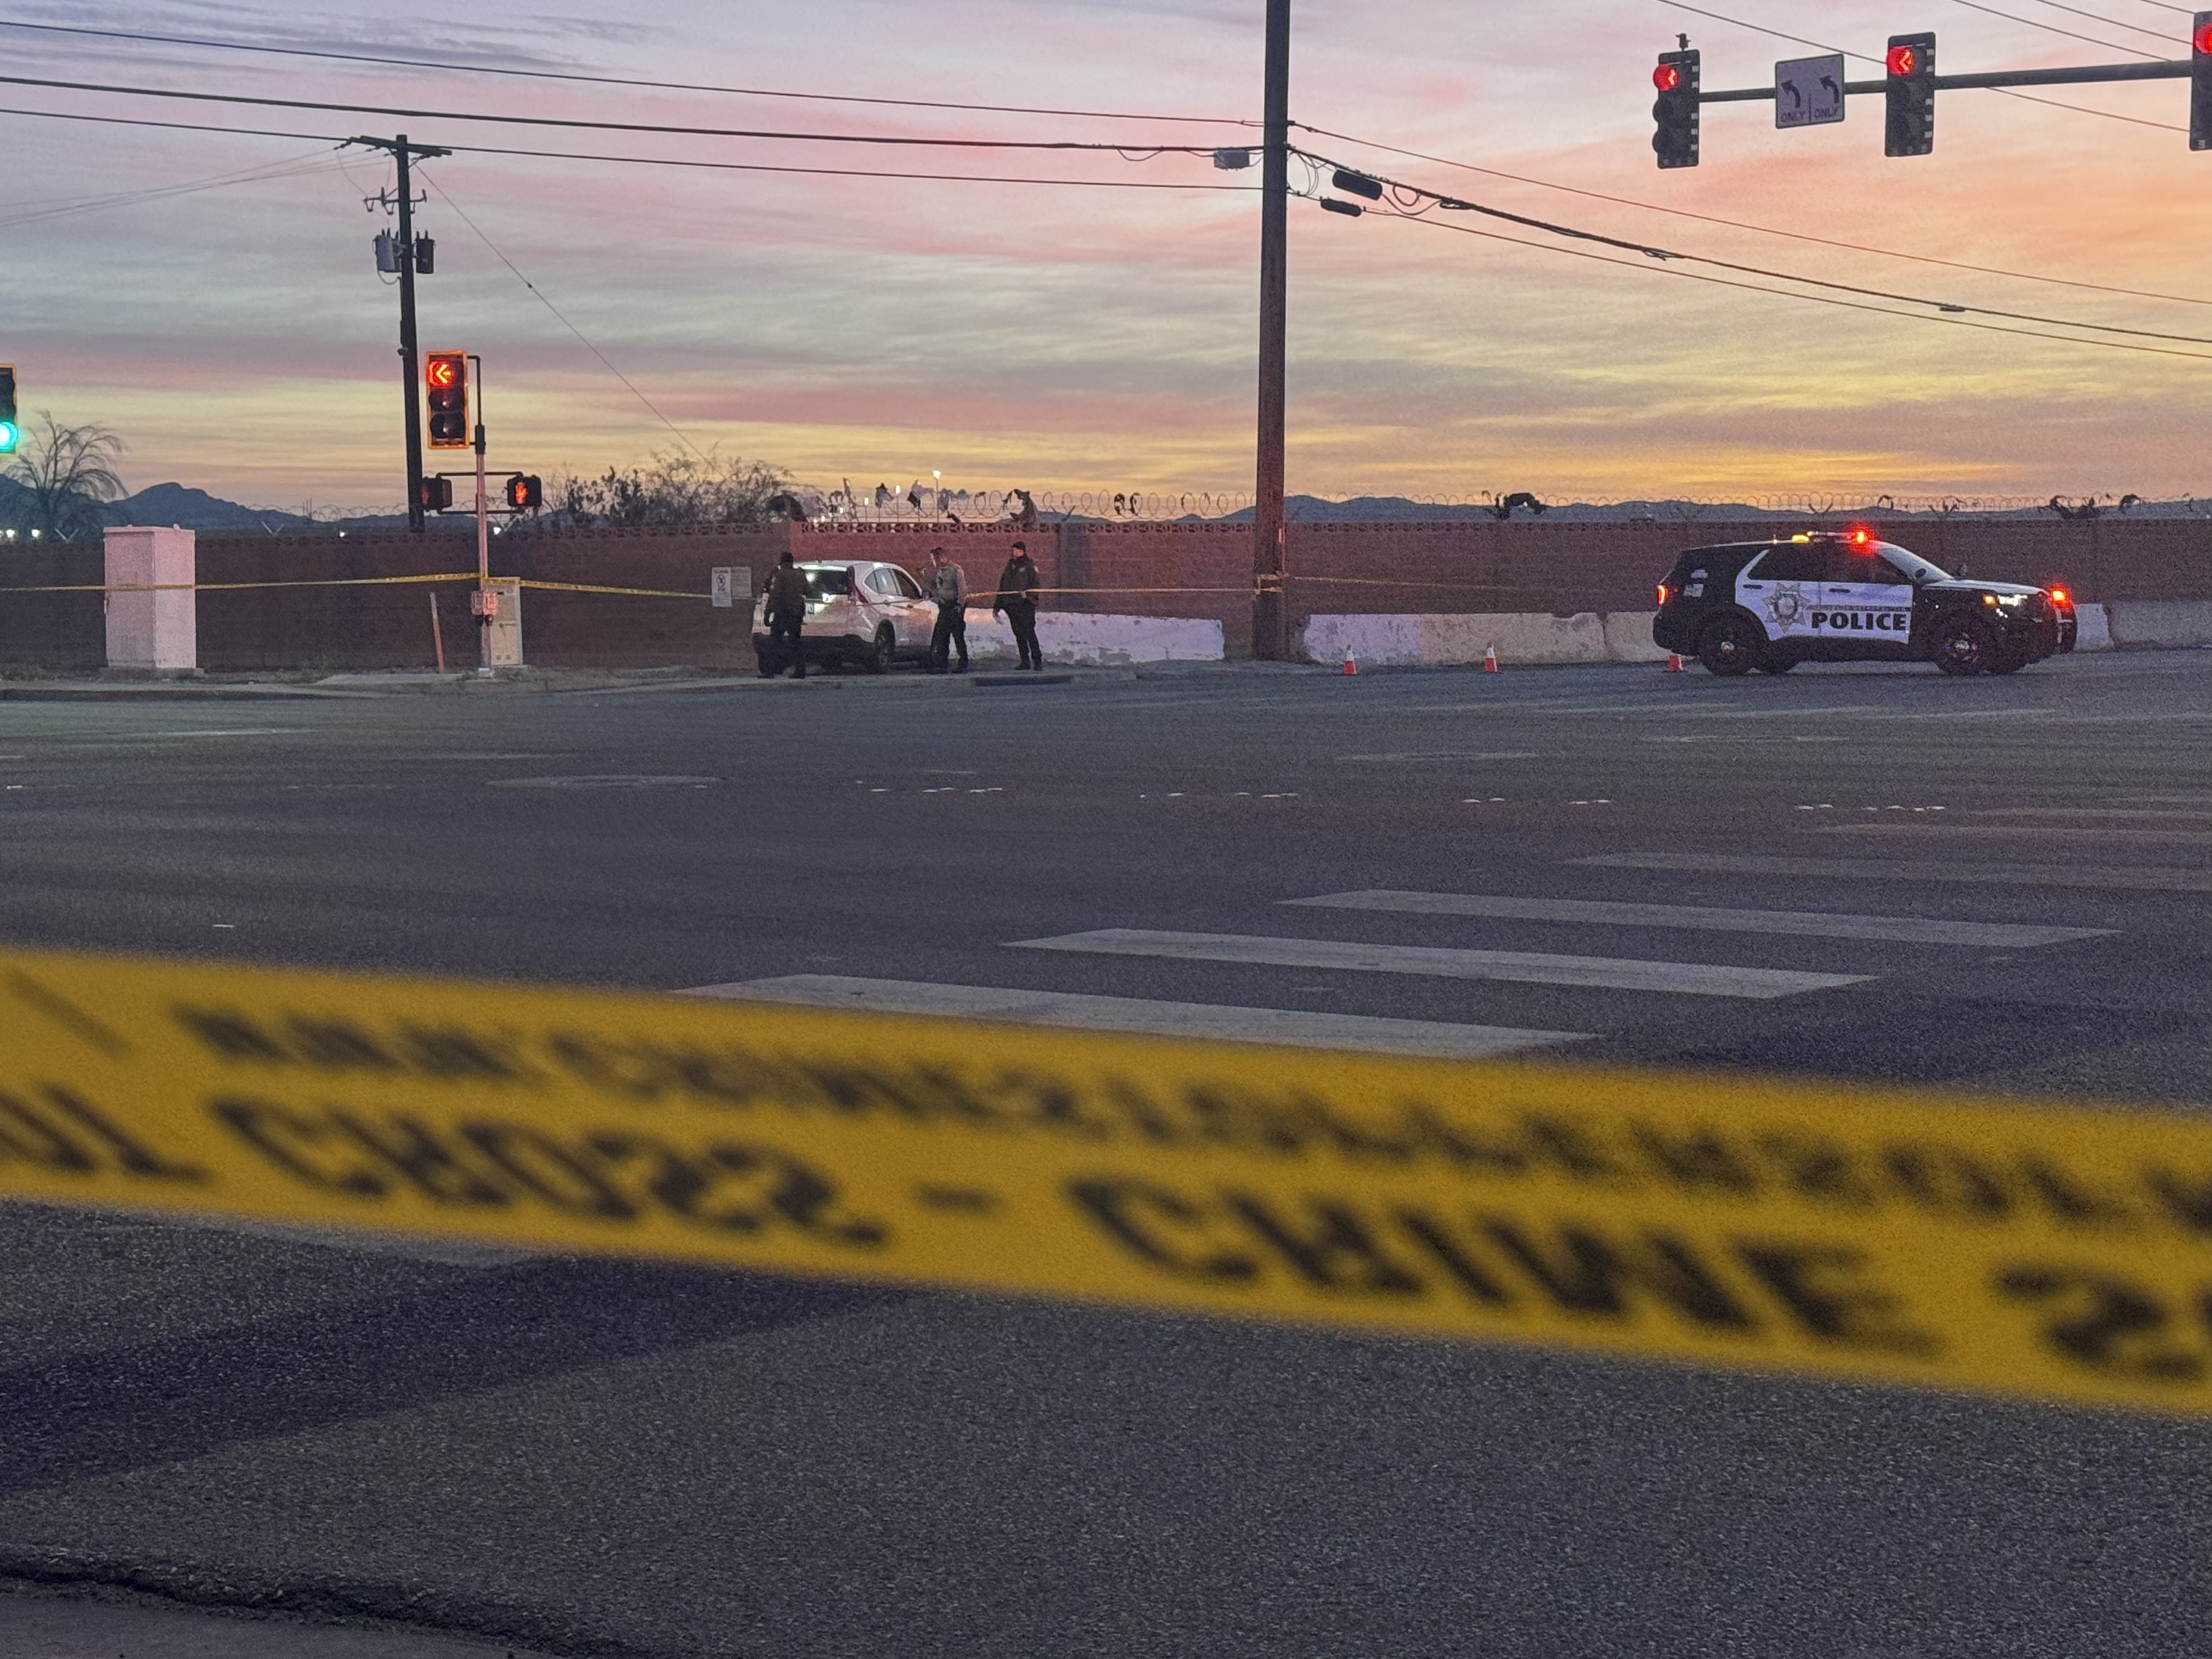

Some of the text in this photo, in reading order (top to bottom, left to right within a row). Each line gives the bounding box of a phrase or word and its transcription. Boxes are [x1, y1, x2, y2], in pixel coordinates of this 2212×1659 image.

[1781, 111, 1805, 123] ONLY
[1814, 107, 1838, 119] ONLY
[1812, 612, 1906, 630] POLICE
